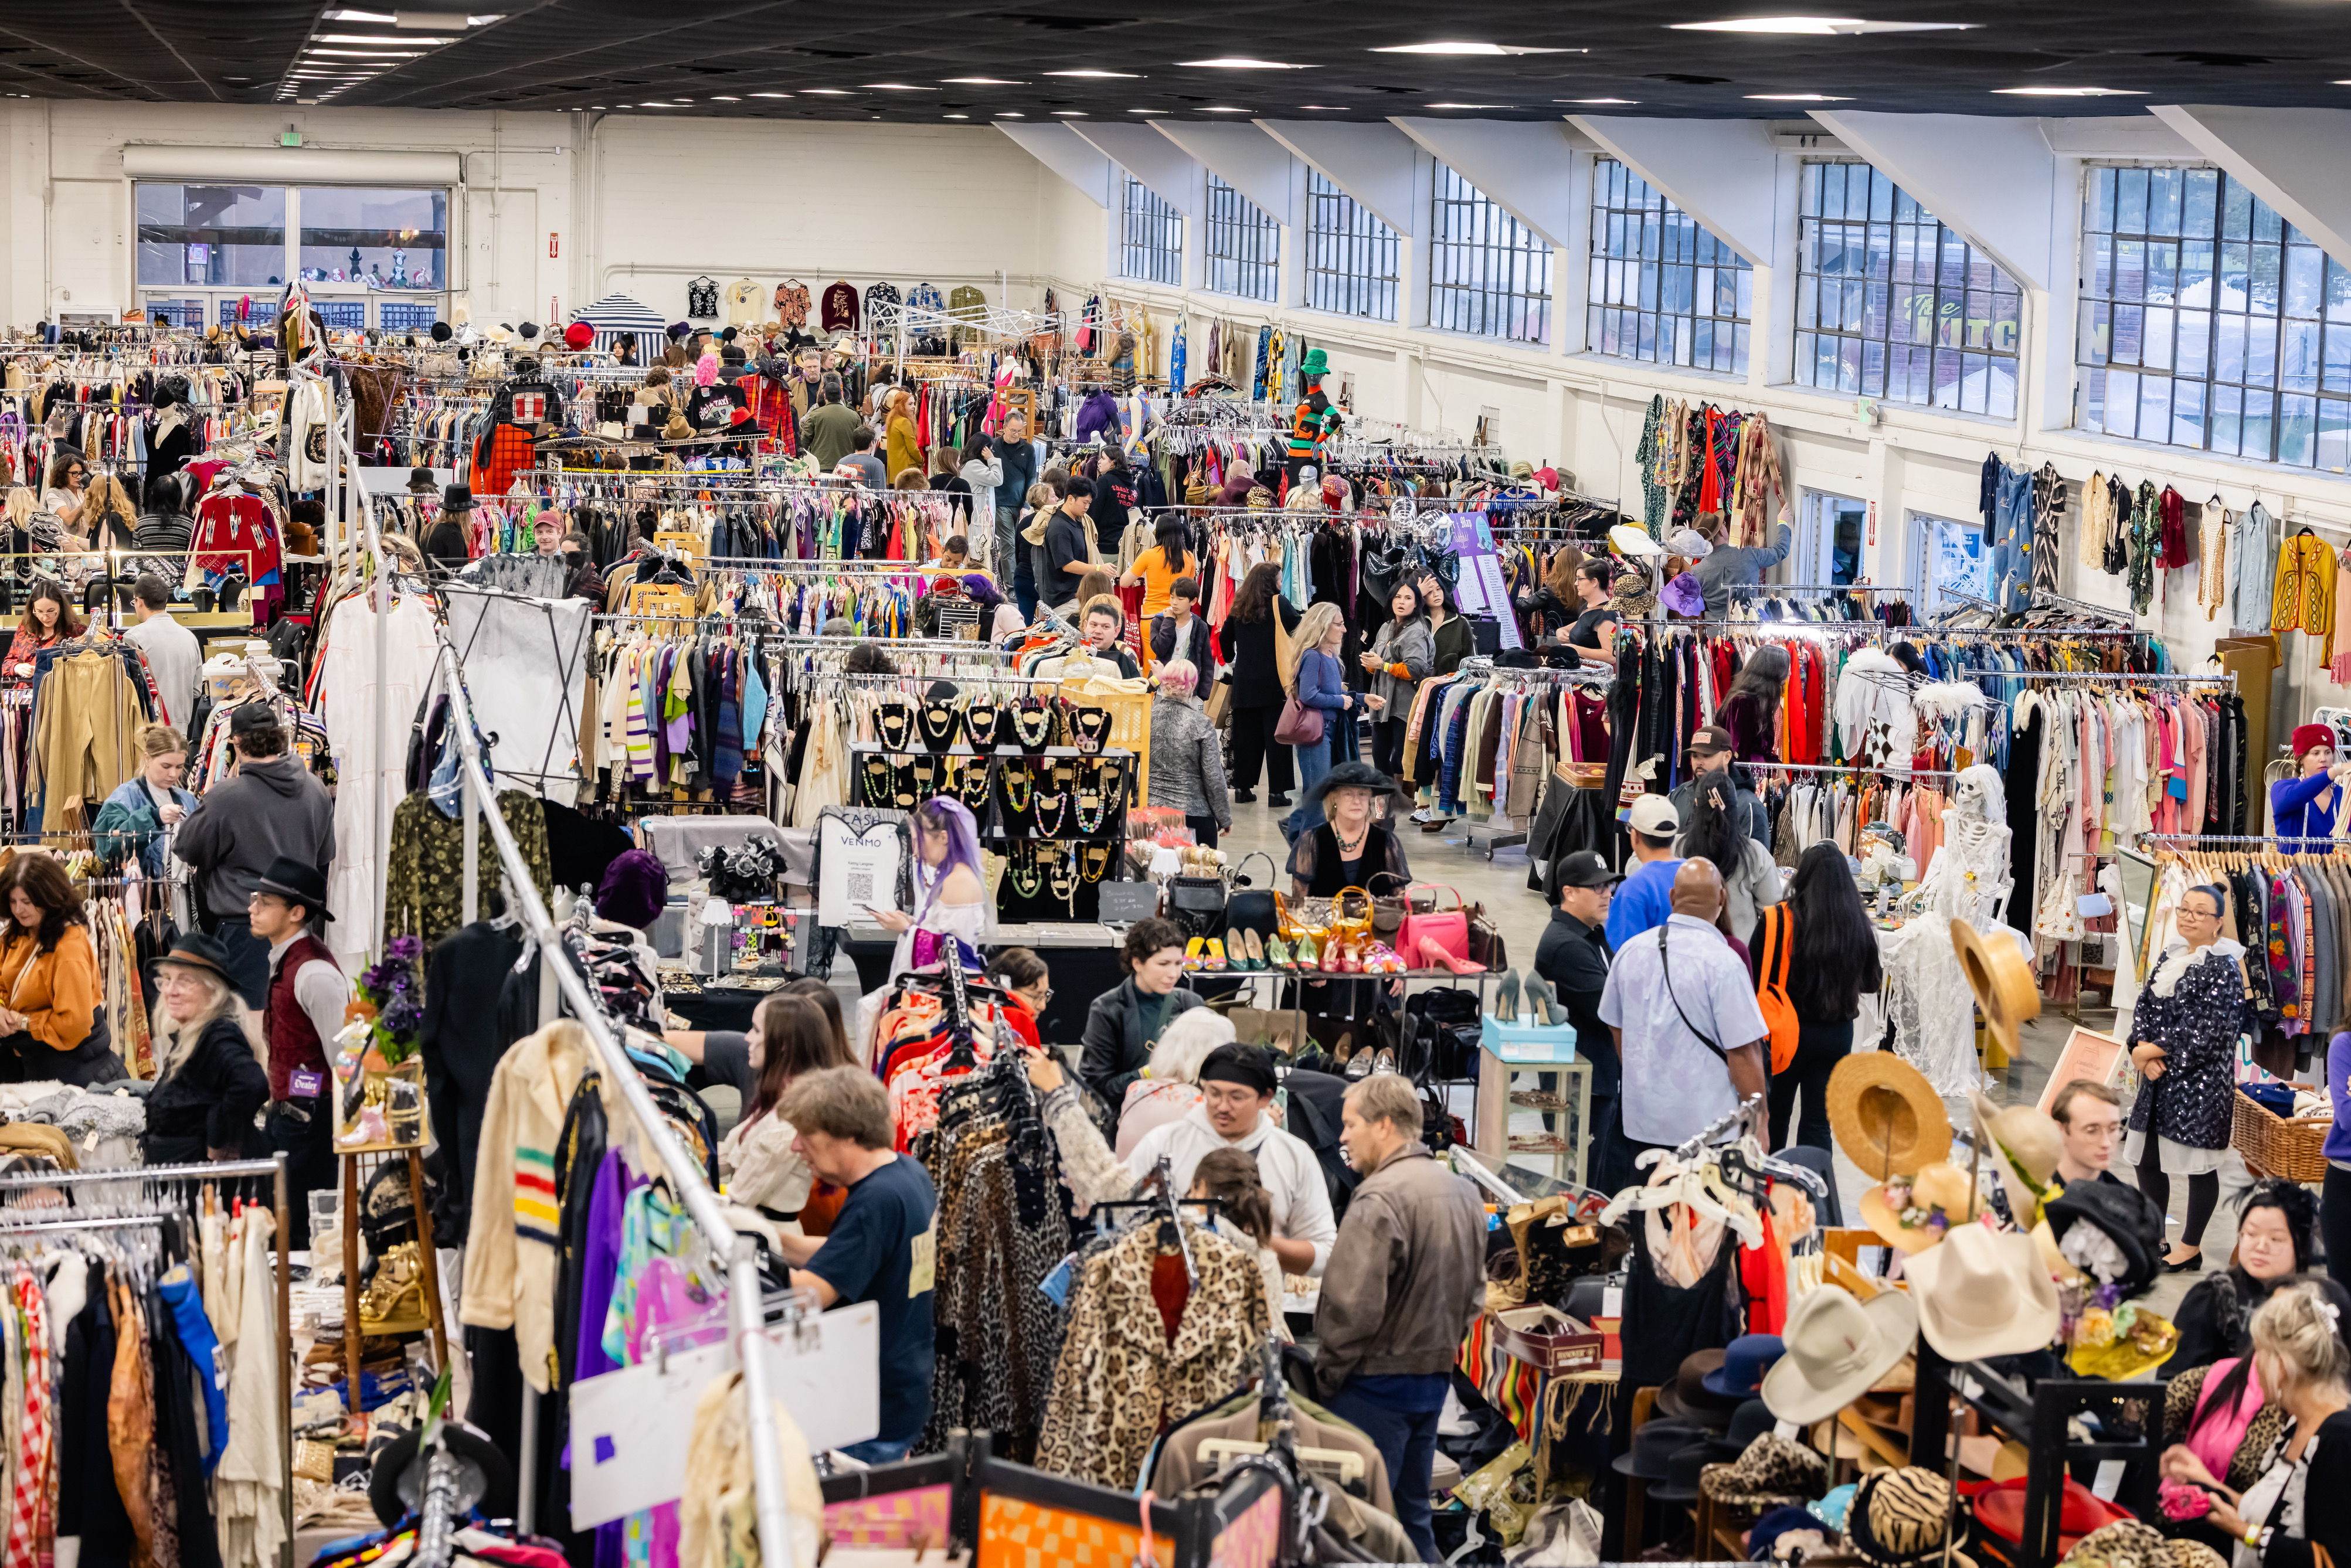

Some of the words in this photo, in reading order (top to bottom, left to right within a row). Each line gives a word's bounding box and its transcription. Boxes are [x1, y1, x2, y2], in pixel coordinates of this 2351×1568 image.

[284, 132, 300, 145] EXIT
[1860, 399, 1870, 423] EXIT
[1111, 484, 1129, 494] thank
[1117, 491, 1127, 499] for
[1119, 499, 1133, 508] veno
[842, 814, 881, 825] CASH
[841, 836, 881, 848] VENMO
[294, 1079, 317, 1090] Dealer
